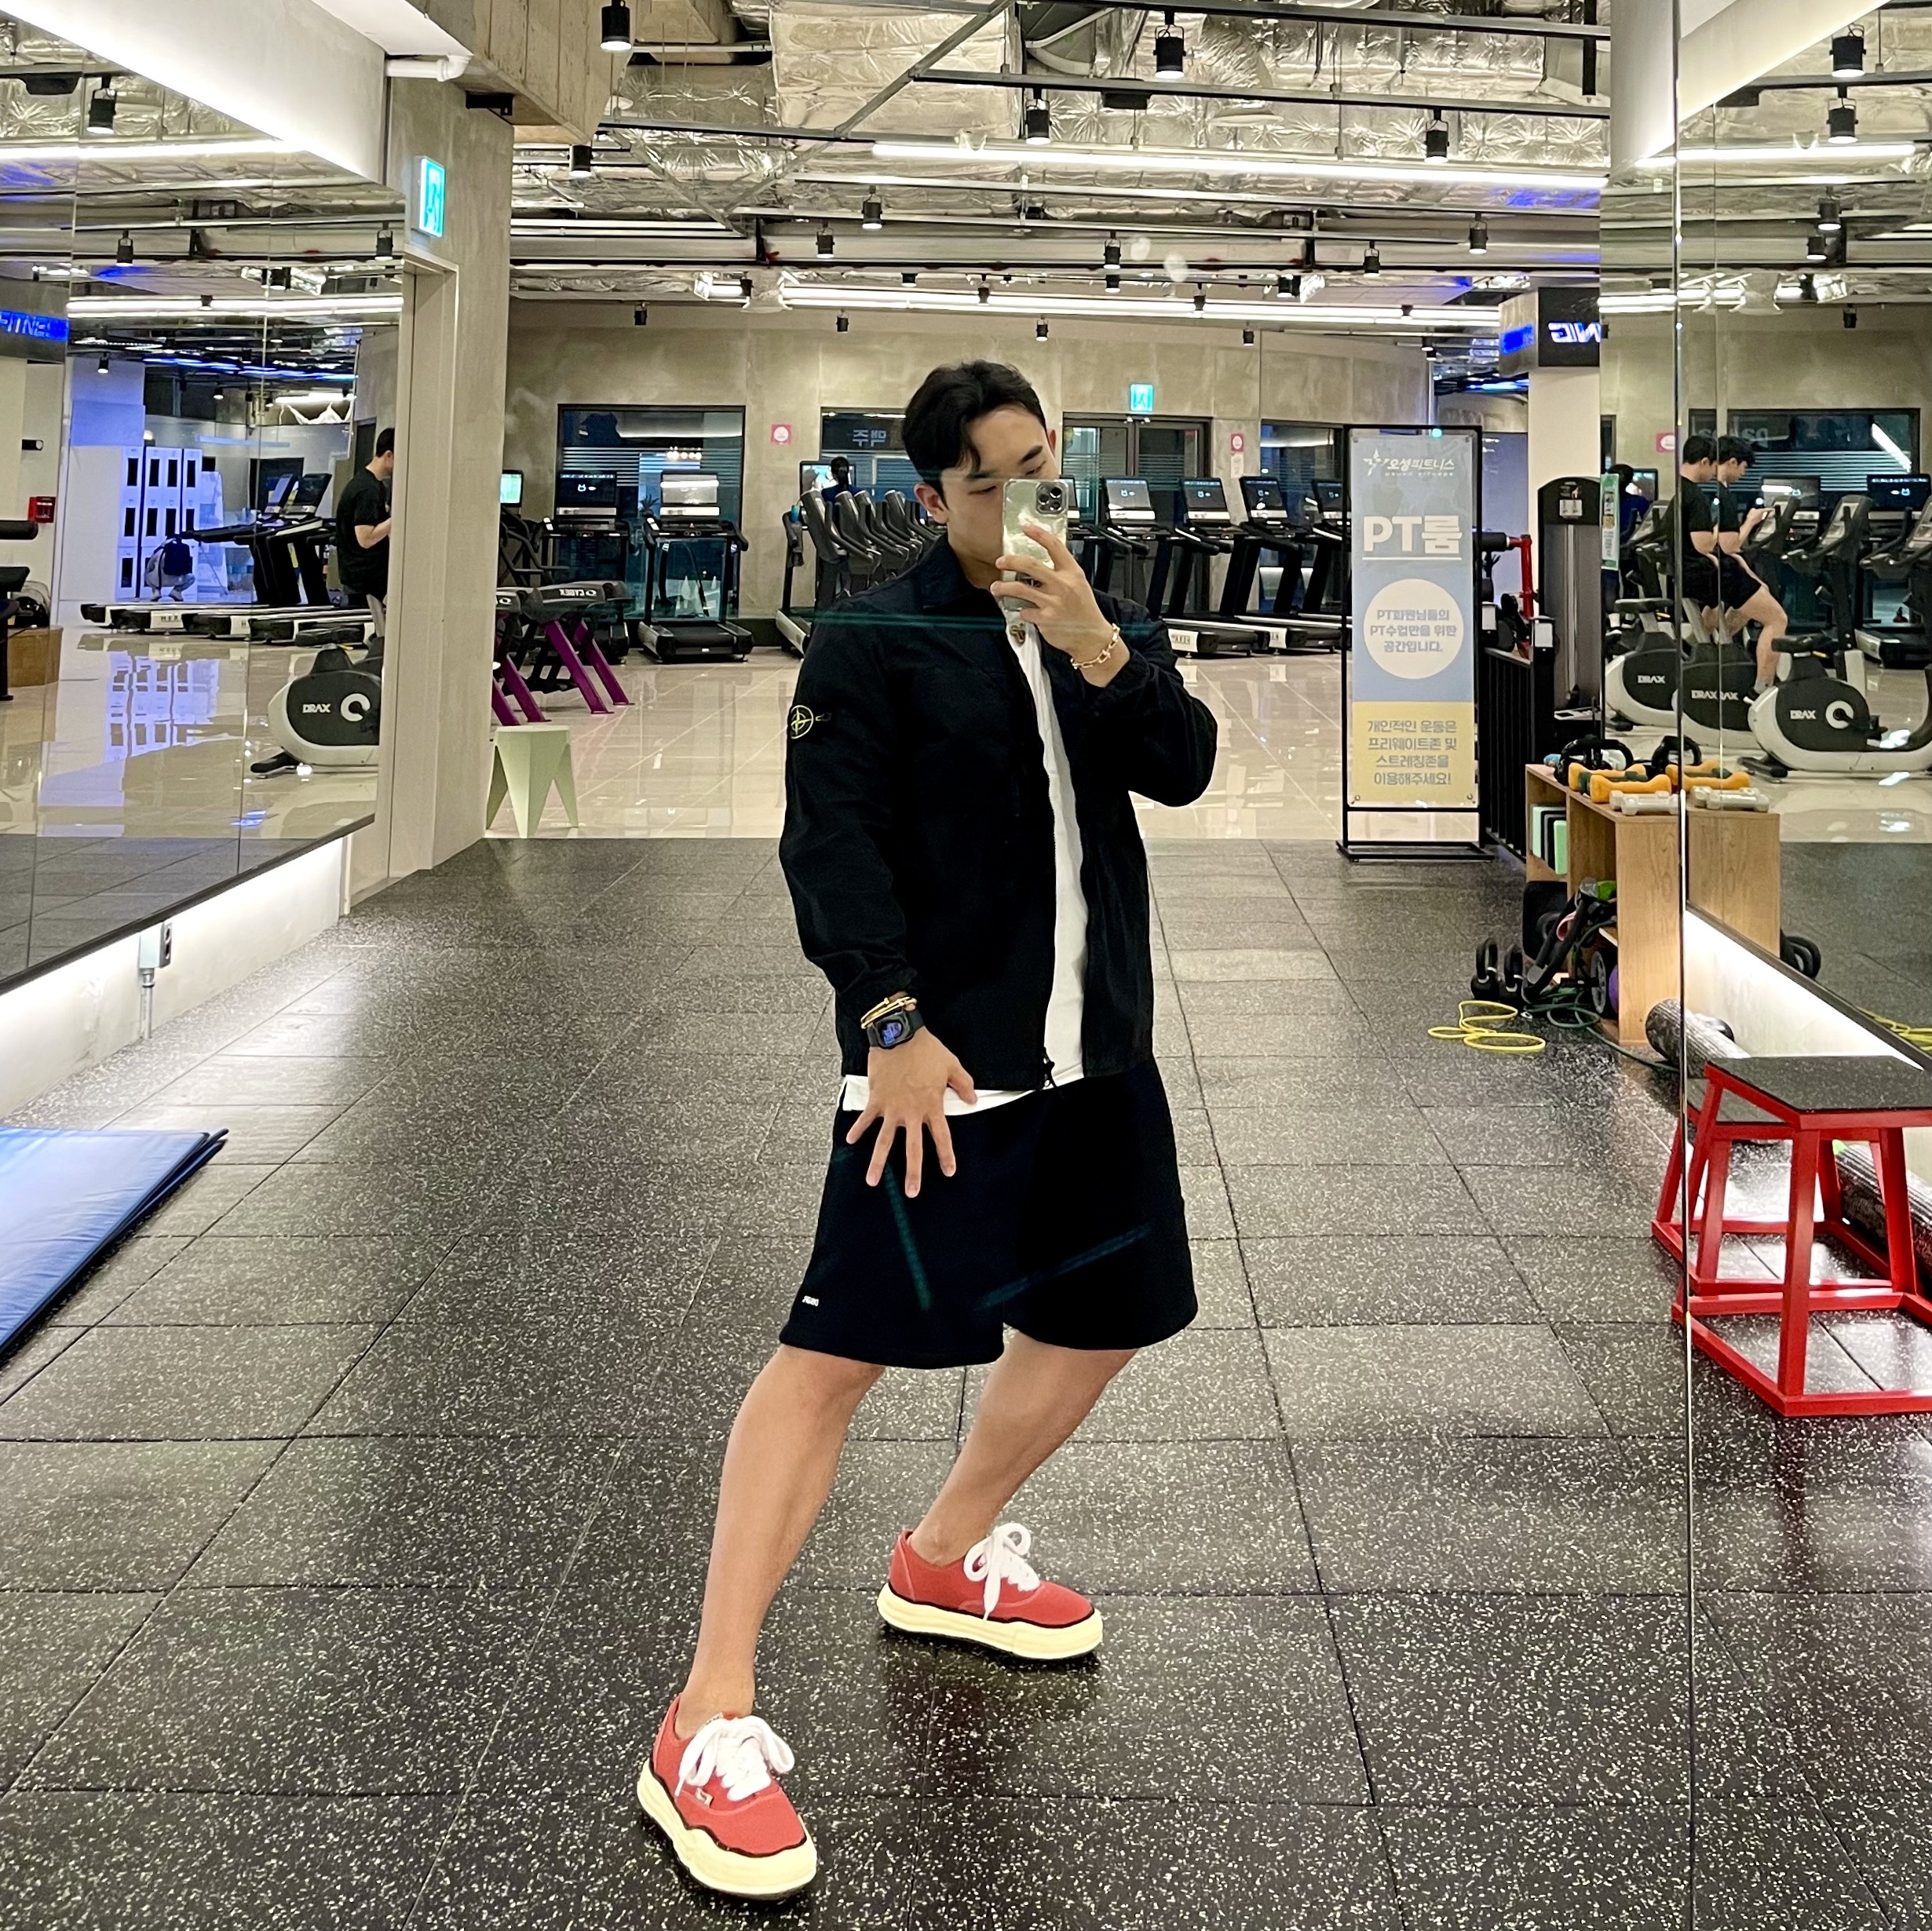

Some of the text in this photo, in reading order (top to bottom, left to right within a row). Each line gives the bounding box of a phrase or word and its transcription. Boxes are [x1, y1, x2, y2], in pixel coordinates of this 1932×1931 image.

[1387, 458, 1455, 471] 오성피트니스
[1364, 516, 1463, 553] PT룸
[1377, 609, 1449, 621] PT회원님들의
[1370, 625, 1457, 637] PT수업만을 위한
[1384, 641, 1443, 652] 공간입니다.
[1638, 675, 1665, 684] DRAX
[1691, 690, 1718, 700] DRAX
[302, 703, 331, 713] DRAX
[1790, 710, 1817, 720] DRAX
[1368, 720, 1457, 733] 개인적인 운동은
[1368, 737, 1456, 750] 프리웨이트존 및
[1376, 755, 1448, 768] 스트레칭존을
[1374, 772, 1451, 785] 이용해주세요!
